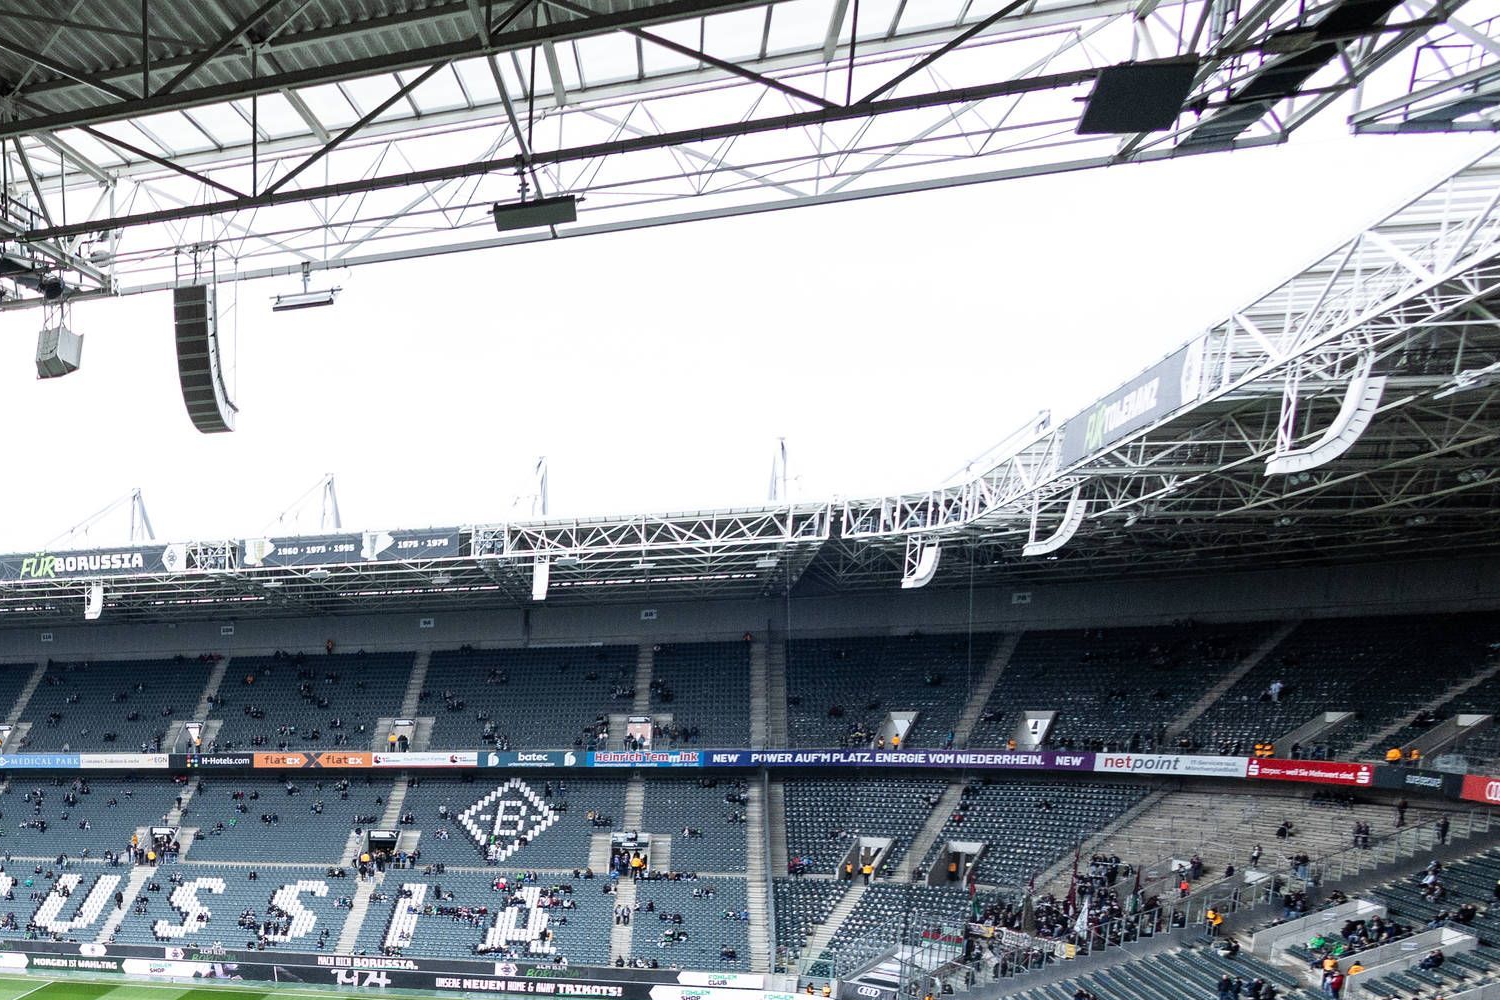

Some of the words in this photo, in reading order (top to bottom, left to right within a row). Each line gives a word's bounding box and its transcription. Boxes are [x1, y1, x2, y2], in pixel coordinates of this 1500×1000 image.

[202, 757, 249, 765] H-Hotels.com
[518, 752, 548, 761] batec
[594, 752, 643, 762] Heinrich
[751, 754, 792, 763] POWER
[832, 754, 873, 763] PLATZ.
[876, 753, 926, 764] ENERGIE
[929, 754, 954, 764] VOM
[957, 754, 1044, 765] NIEDERRHEIN.
[1104, 755, 1180, 771] netpoint
[33, 958, 67, 967] MORGEN
[78, 960, 118, 970] WAHLTAG
[353, 958, 418, 969] BORUSSIA.
[435, 978, 460, 988] UNSERE
[462, 979, 505, 991] NEUEN
[507, 981, 526, 991] HOME
[536, 982, 555, 993] AWAY
[556, 983, 623, 997] TRIKOTS!
